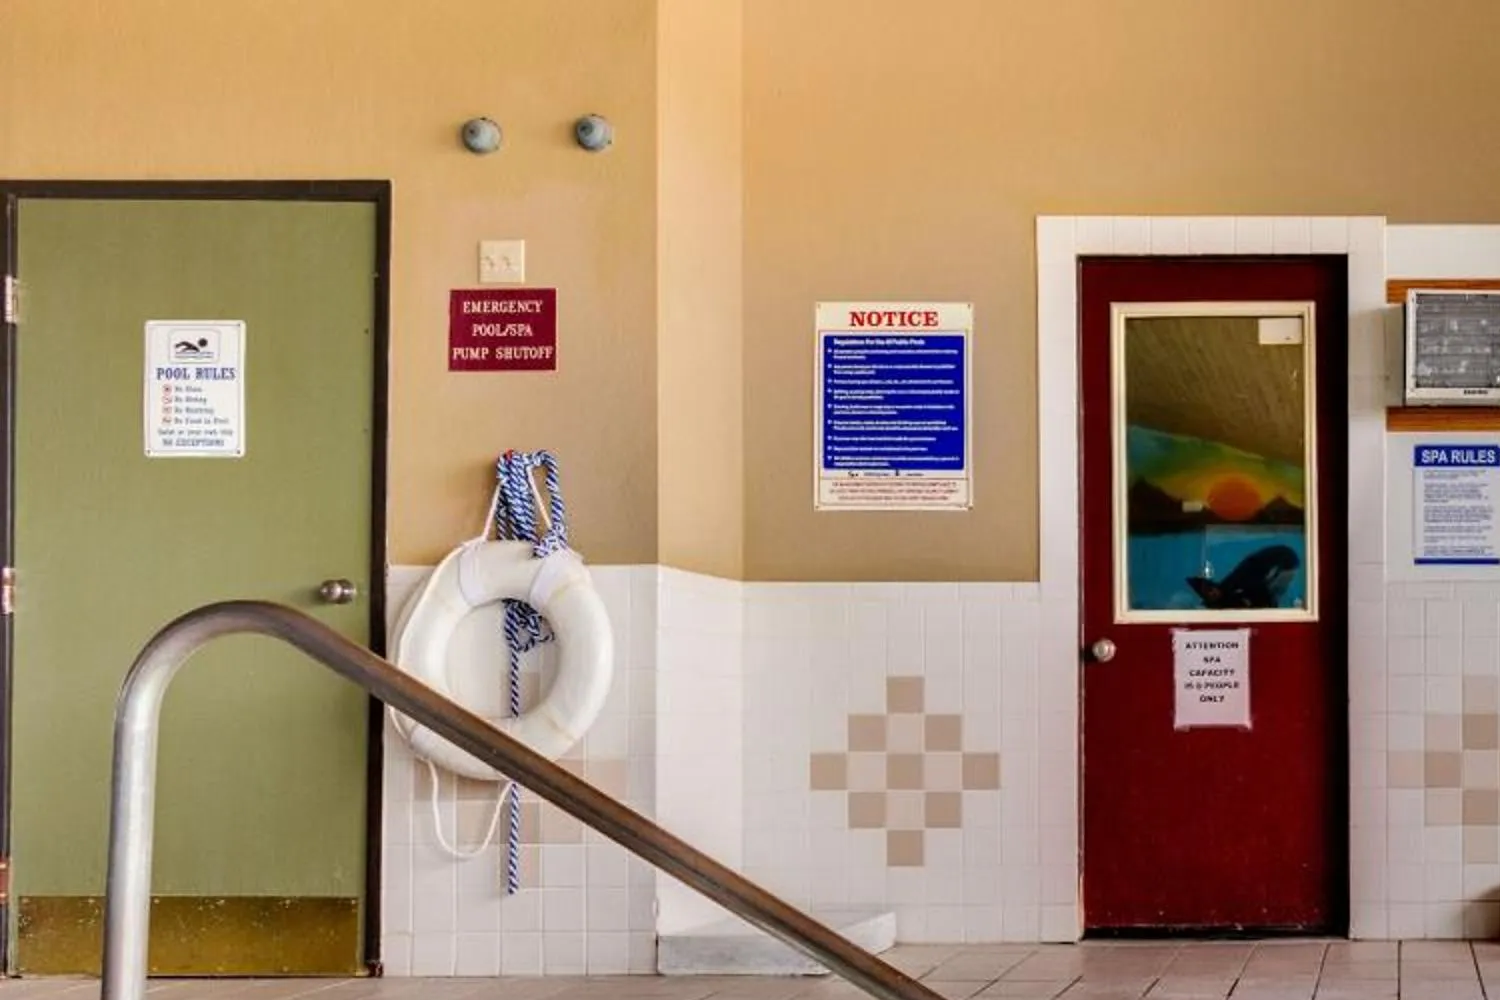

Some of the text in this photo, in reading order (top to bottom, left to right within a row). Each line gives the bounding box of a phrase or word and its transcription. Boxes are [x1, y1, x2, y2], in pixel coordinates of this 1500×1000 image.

[463, 300, 543, 313] EMERGENCY
[848, 311, 939, 327] NOTICE
[472, 323, 533, 337] POOL/SPA
[453, 346, 553, 360] PUMP SHUTOFF
[156, 367, 236, 380] POOL RULES
[1421, 449, 1497, 463] SPA RULES
[1185, 642, 1240, 650] ATTENTION
[1188, 669, 1236, 677] CAPACITY
[1199, 694, 1225, 703] ONLY
